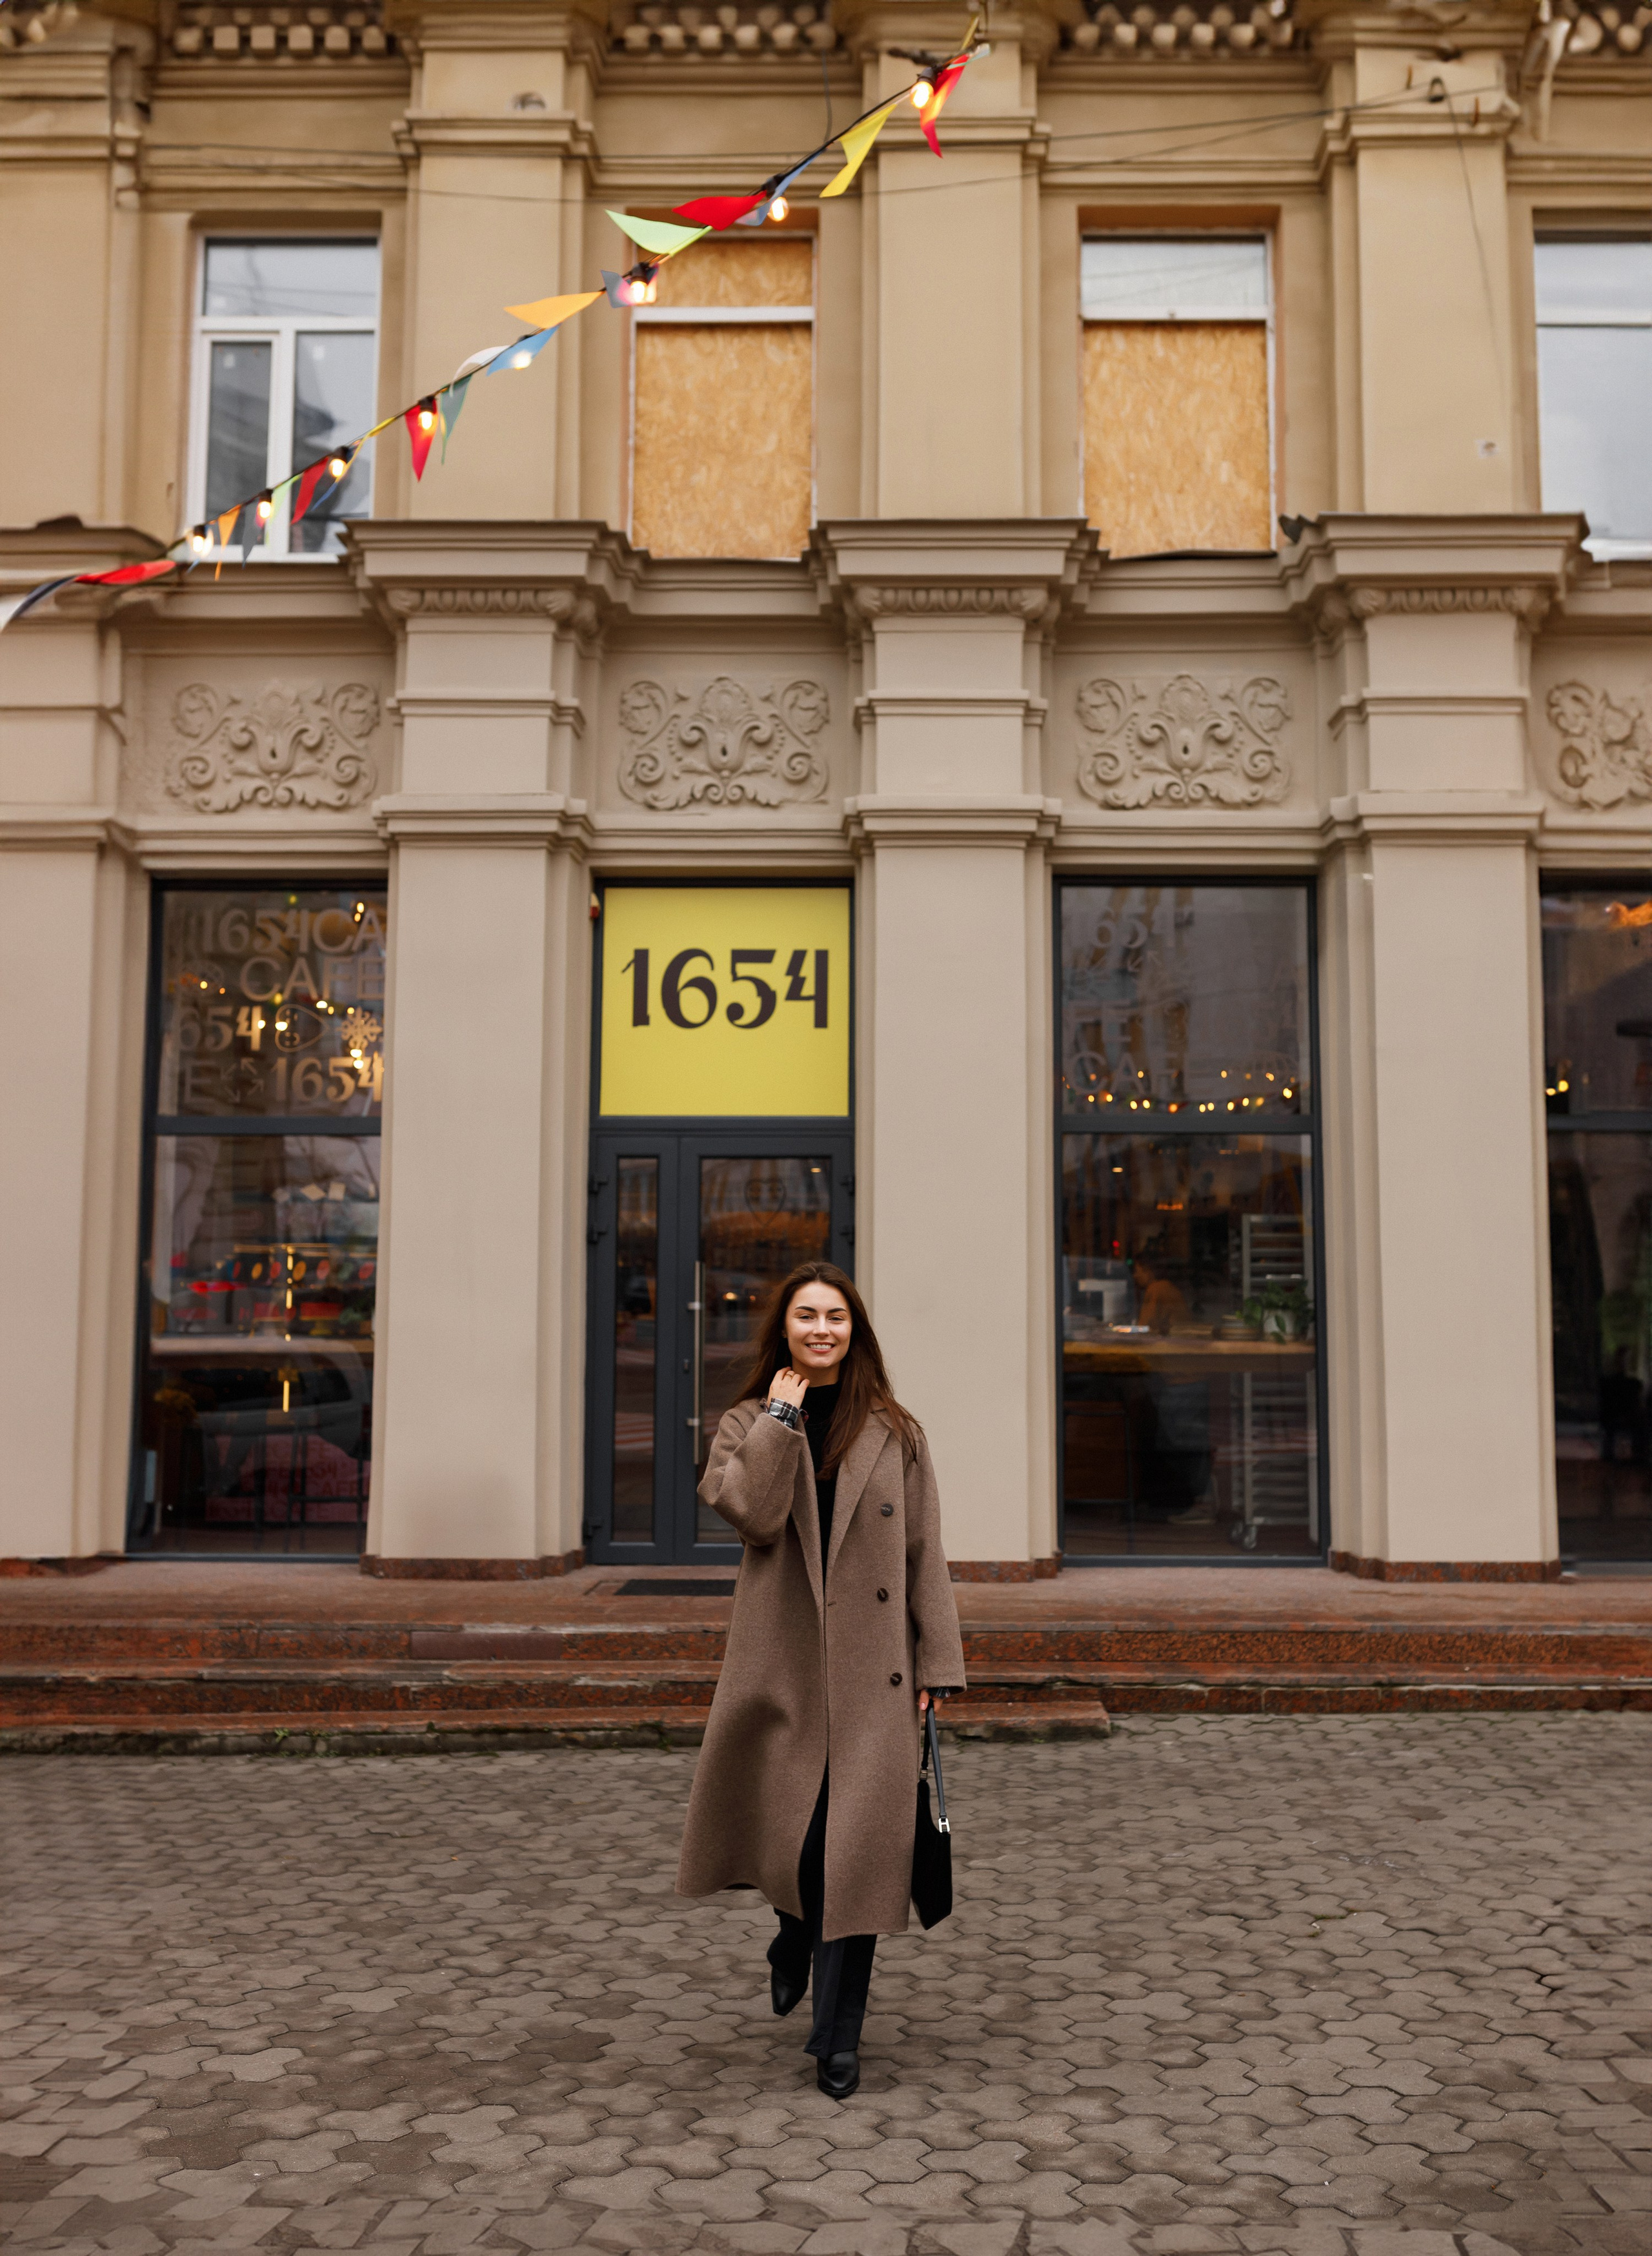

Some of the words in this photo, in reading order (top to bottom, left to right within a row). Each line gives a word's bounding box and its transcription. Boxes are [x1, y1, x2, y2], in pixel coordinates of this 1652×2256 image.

[239, 955, 385, 1002] CAFE
[621, 948, 829, 1028] 1654
[270, 1052, 384, 1103] 1654
